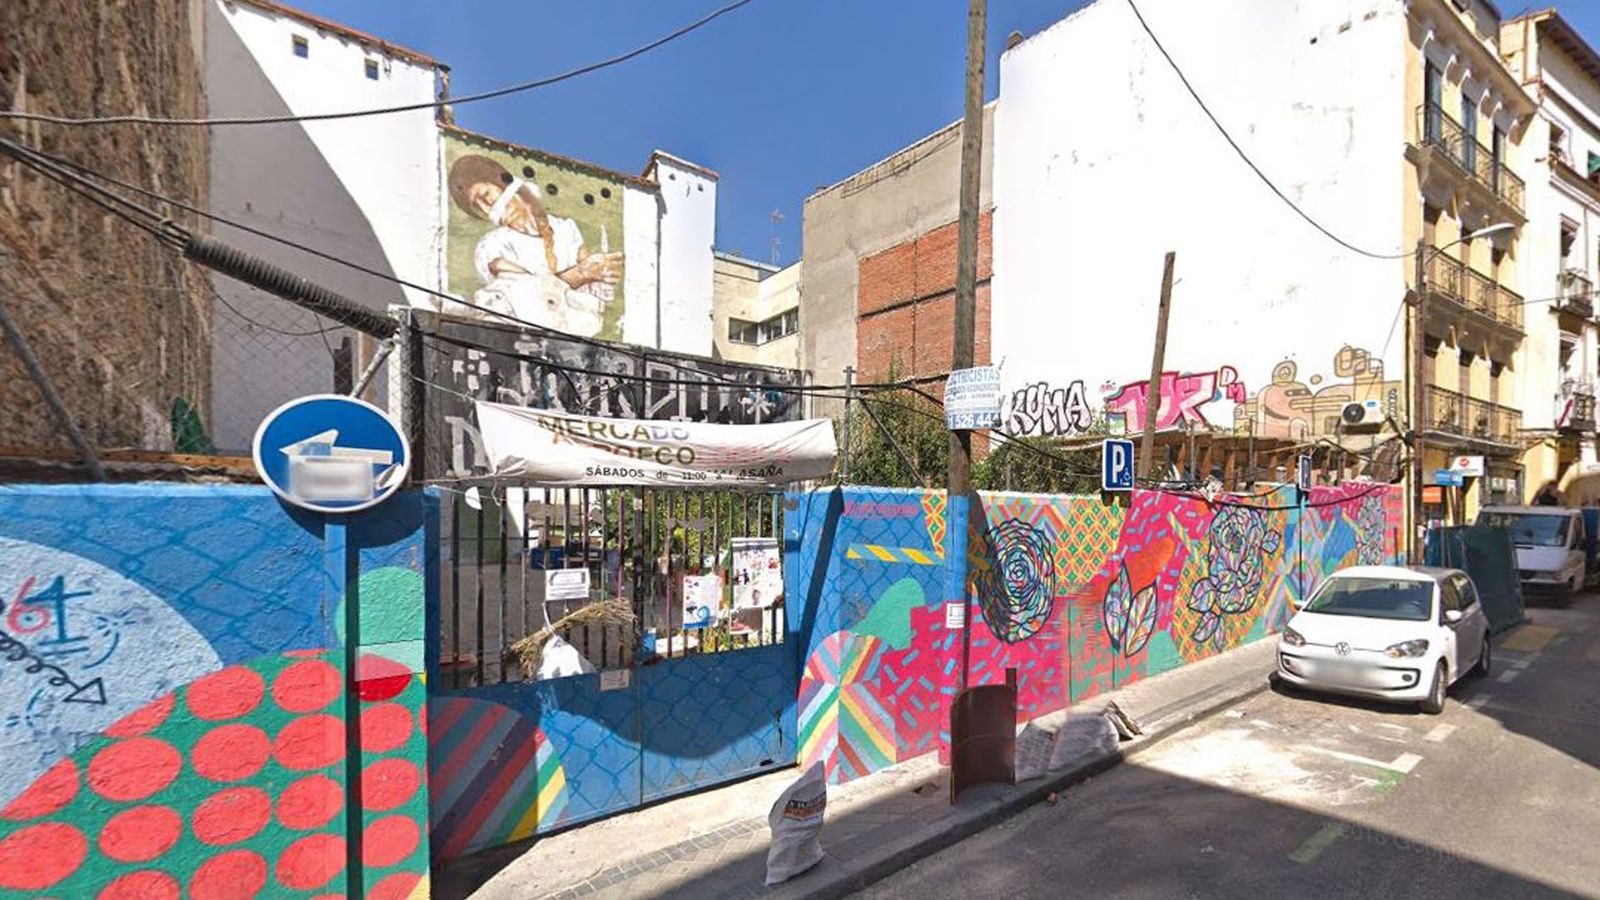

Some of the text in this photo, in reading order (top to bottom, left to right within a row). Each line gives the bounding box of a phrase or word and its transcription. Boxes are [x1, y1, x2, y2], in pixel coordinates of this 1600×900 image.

[537, 414, 690, 441] MERCADO
[586, 465, 645, 478] SÁBADOS
[1112, 444, 1125, 484] P
